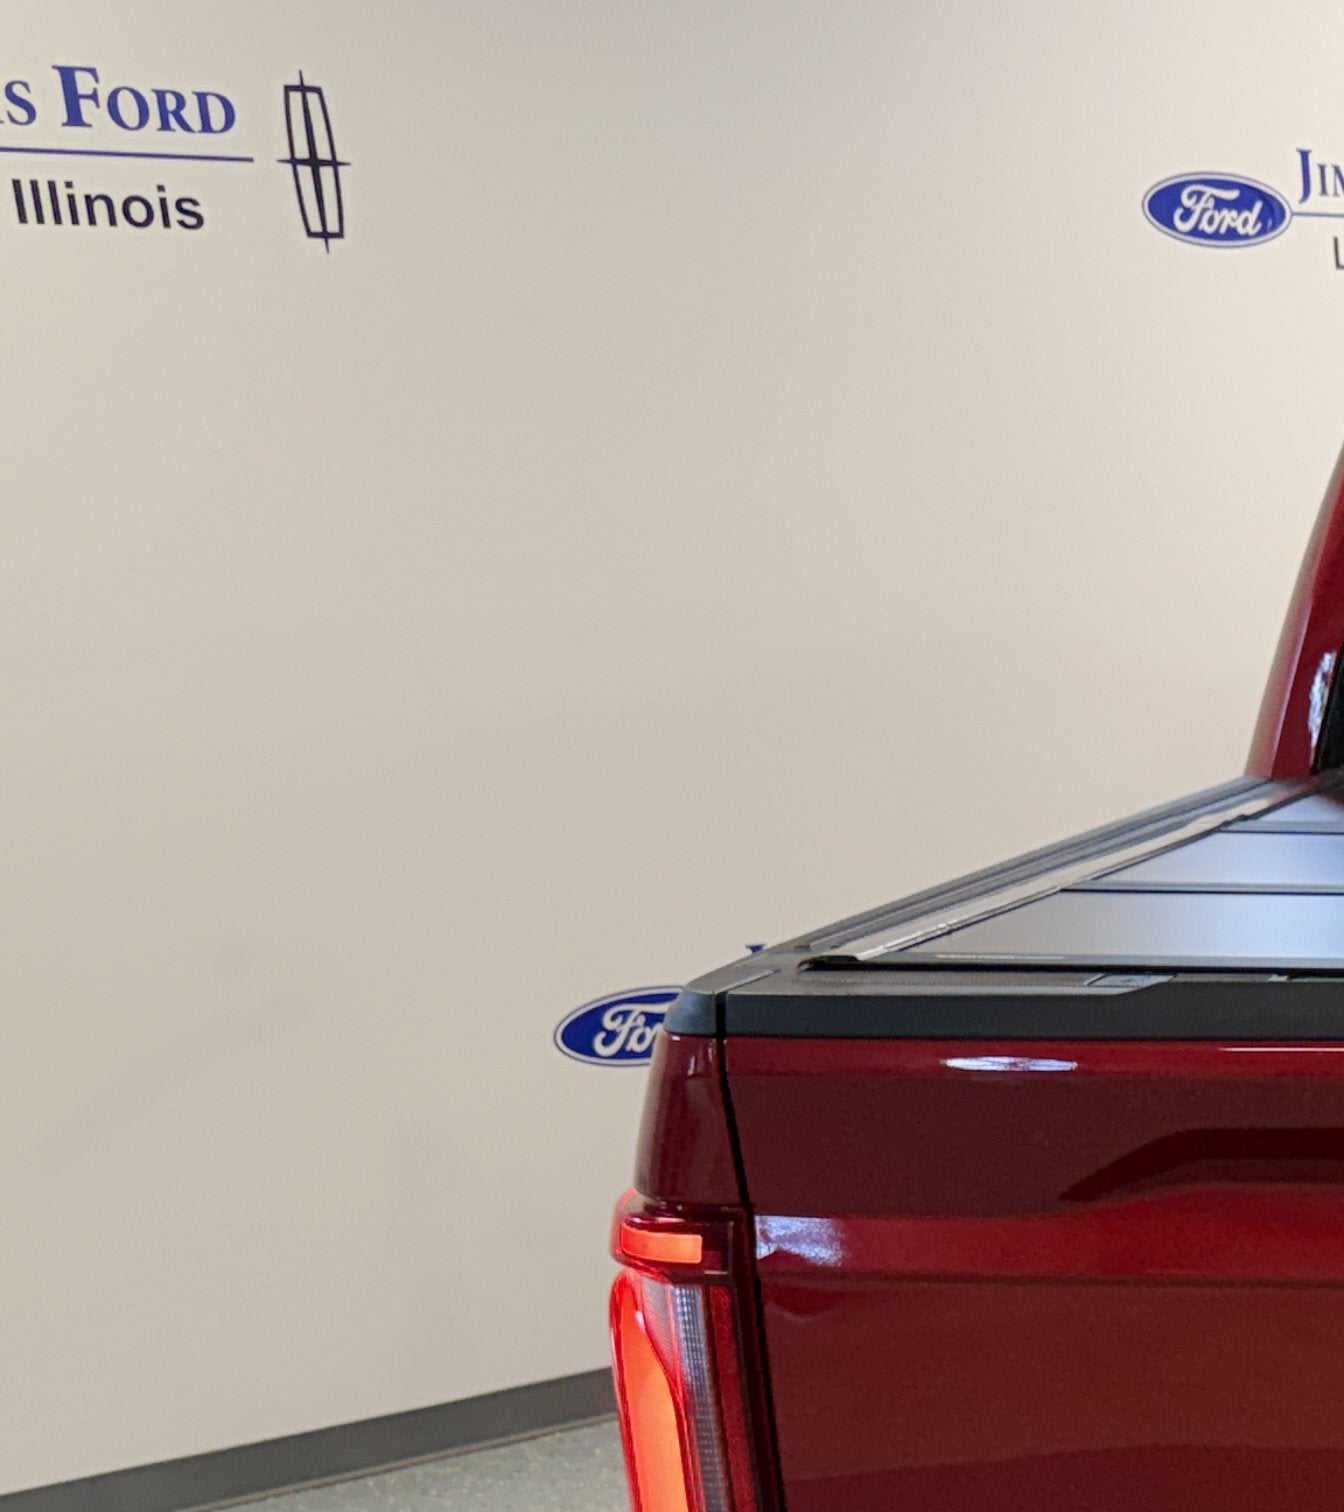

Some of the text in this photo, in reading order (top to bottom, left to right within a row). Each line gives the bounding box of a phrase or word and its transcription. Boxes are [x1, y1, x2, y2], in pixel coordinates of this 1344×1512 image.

[52, 64, 236, 134] FORD
[11, 178, 205, 231] Illinois
[1173, 183, 1262, 238] Ford
[593, 1003, 670, 1057] Fo
